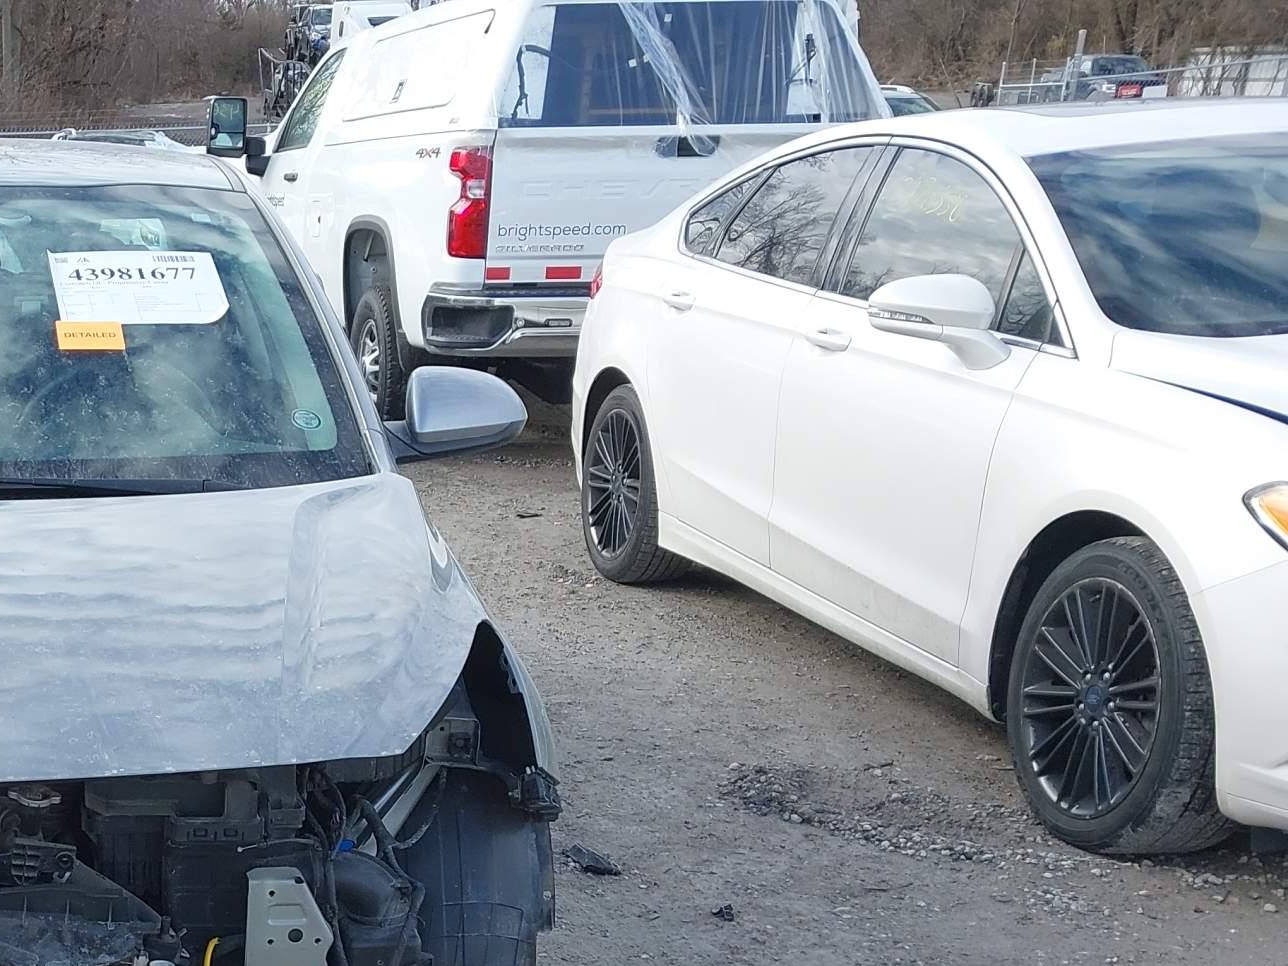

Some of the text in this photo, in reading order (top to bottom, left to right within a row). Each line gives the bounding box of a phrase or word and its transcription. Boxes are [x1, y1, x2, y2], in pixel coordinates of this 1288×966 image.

[520, 178, 714, 199] CHEVR
[498, 222, 627, 241] brightspeed.com
[68, 266, 195, 281] 43981677
[64, 331, 117, 339] DETAILED
